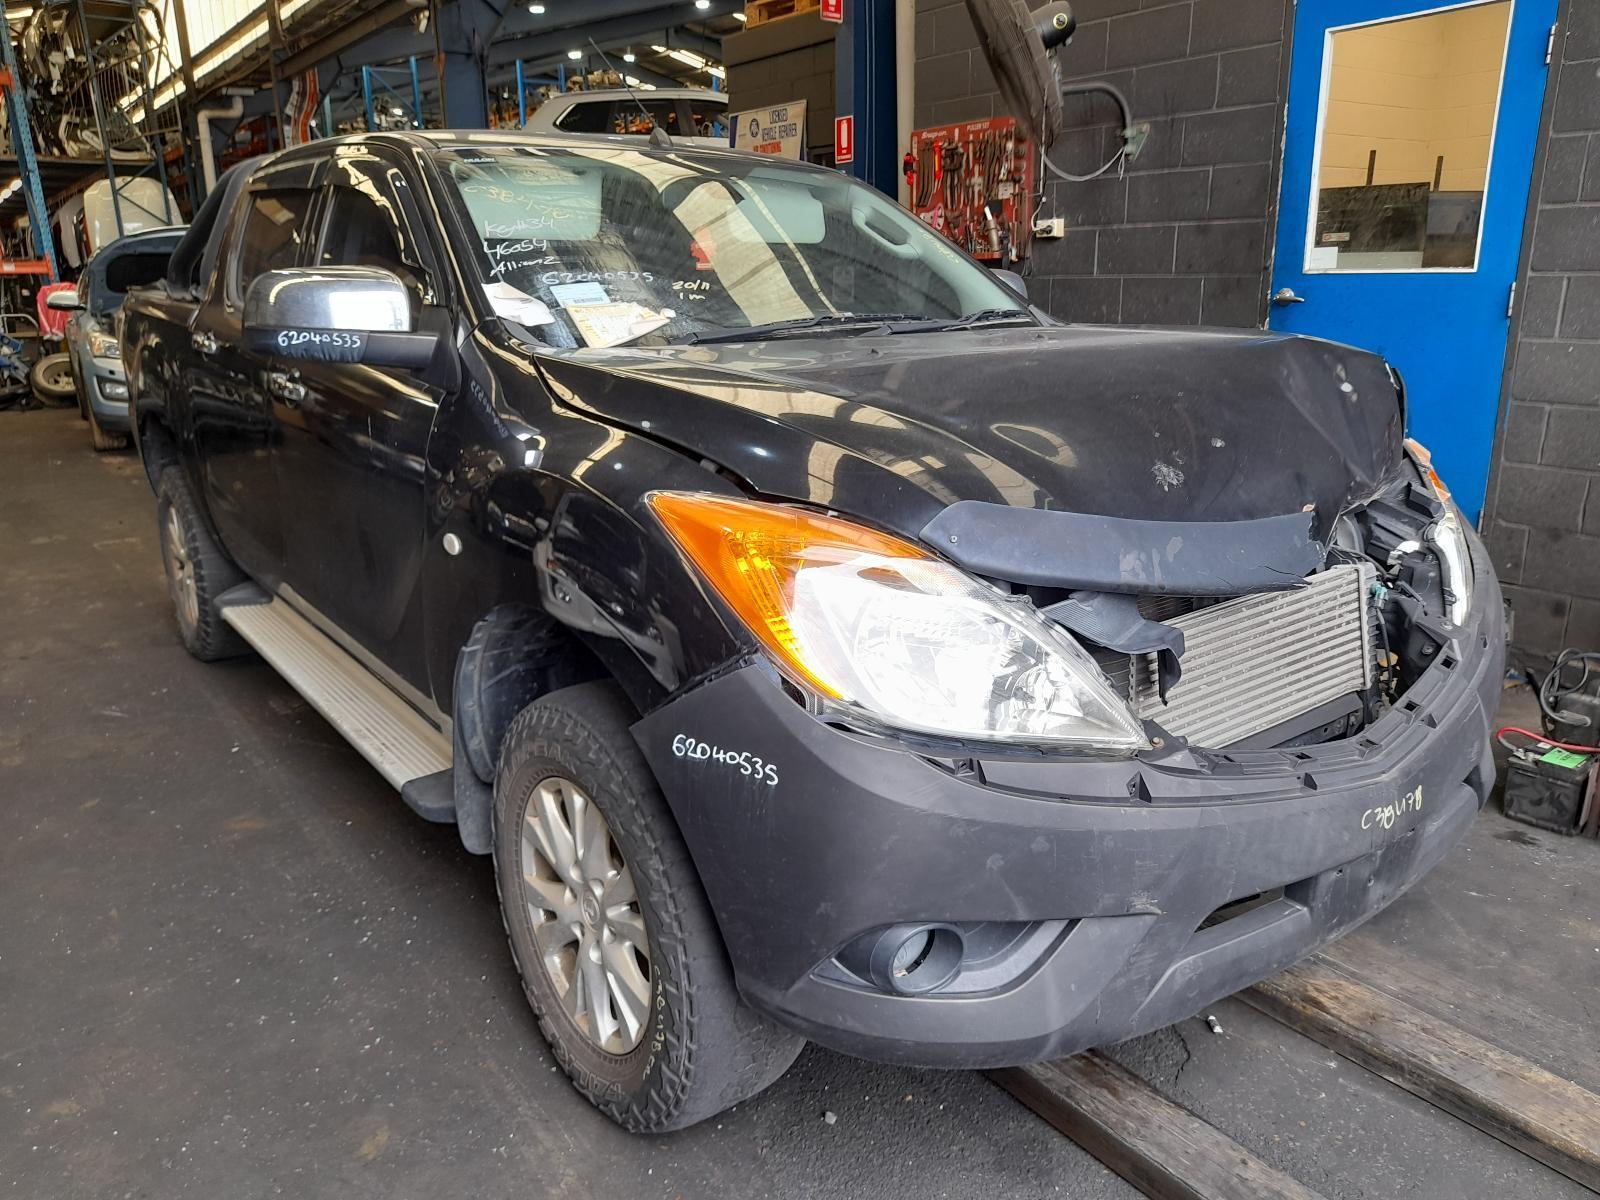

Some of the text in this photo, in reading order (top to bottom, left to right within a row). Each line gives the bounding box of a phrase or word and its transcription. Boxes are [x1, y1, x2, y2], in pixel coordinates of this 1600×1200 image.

[761, 126, 777, 142] VEHICLE
[483, 238, 547, 260] 46054
[277, 330, 361, 348] 62040535
[672, 734, 779, 786] 62040535
